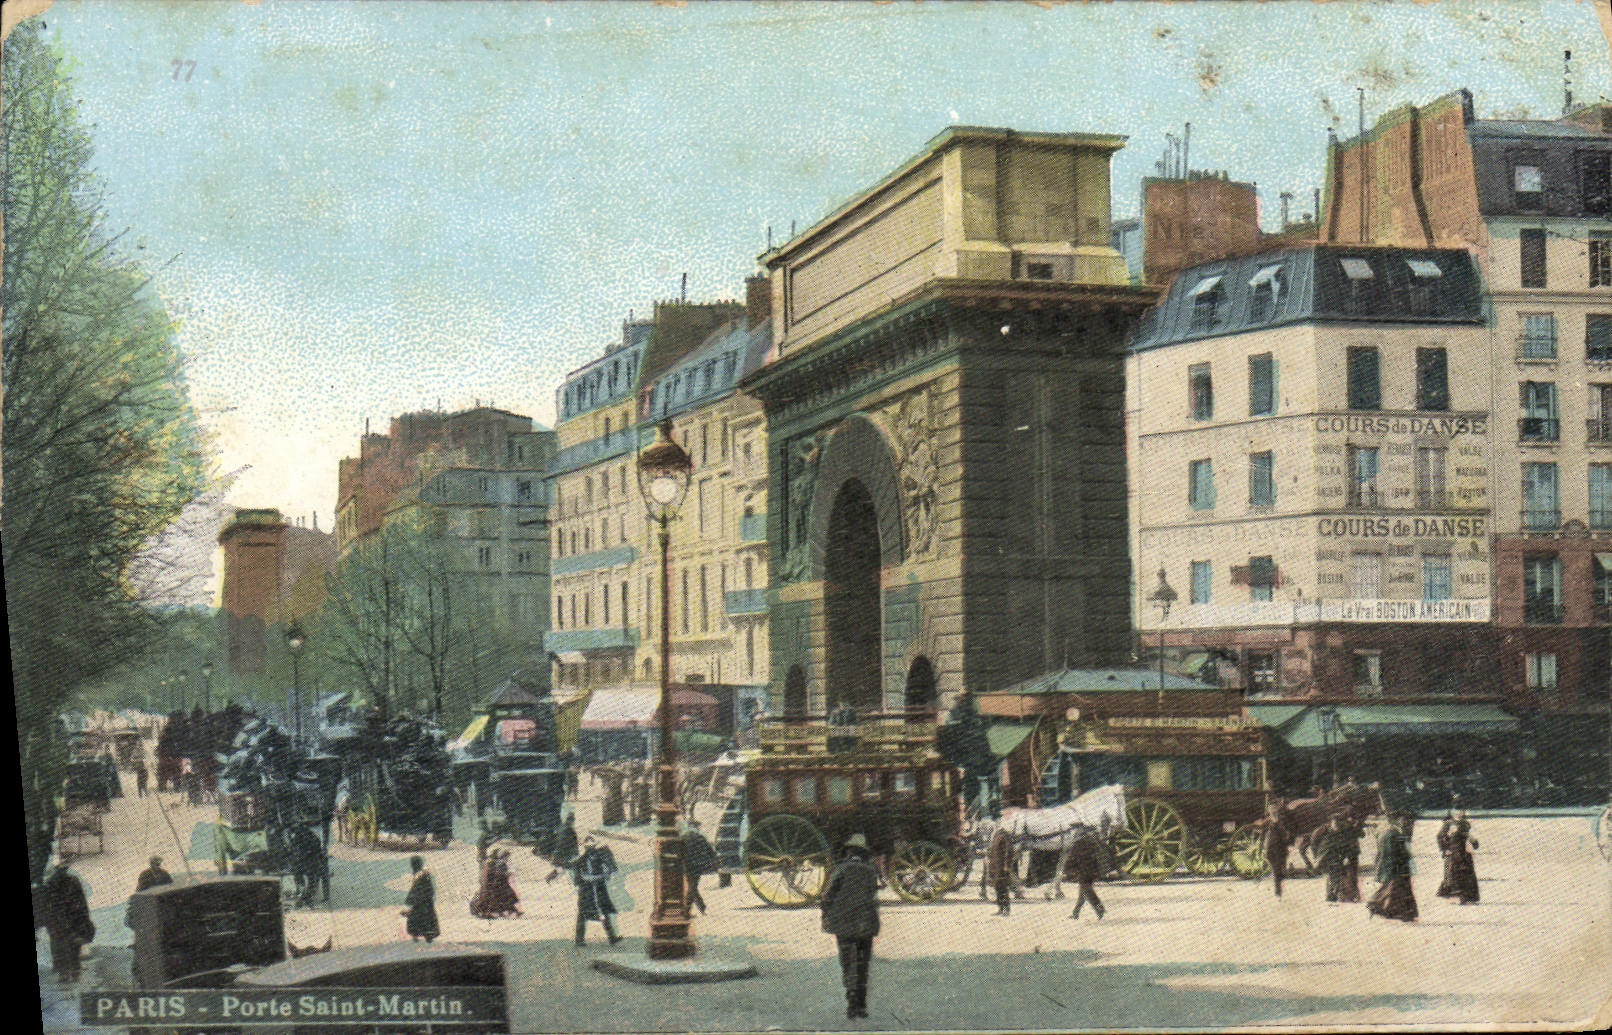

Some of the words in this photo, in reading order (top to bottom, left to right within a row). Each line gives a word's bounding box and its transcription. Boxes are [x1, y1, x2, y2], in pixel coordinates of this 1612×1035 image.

[1315, 417, 1389, 434] COURS
[1391, 419, 1408, 434] de
[1410, 418, 1487, 435] DANSE
[1317, 519, 1390, 537] COURS
[1393, 519, 1410, 537] de
[1413, 519, 1486, 537] DANSE
[1376, 602, 1416, 619] BOSTON
